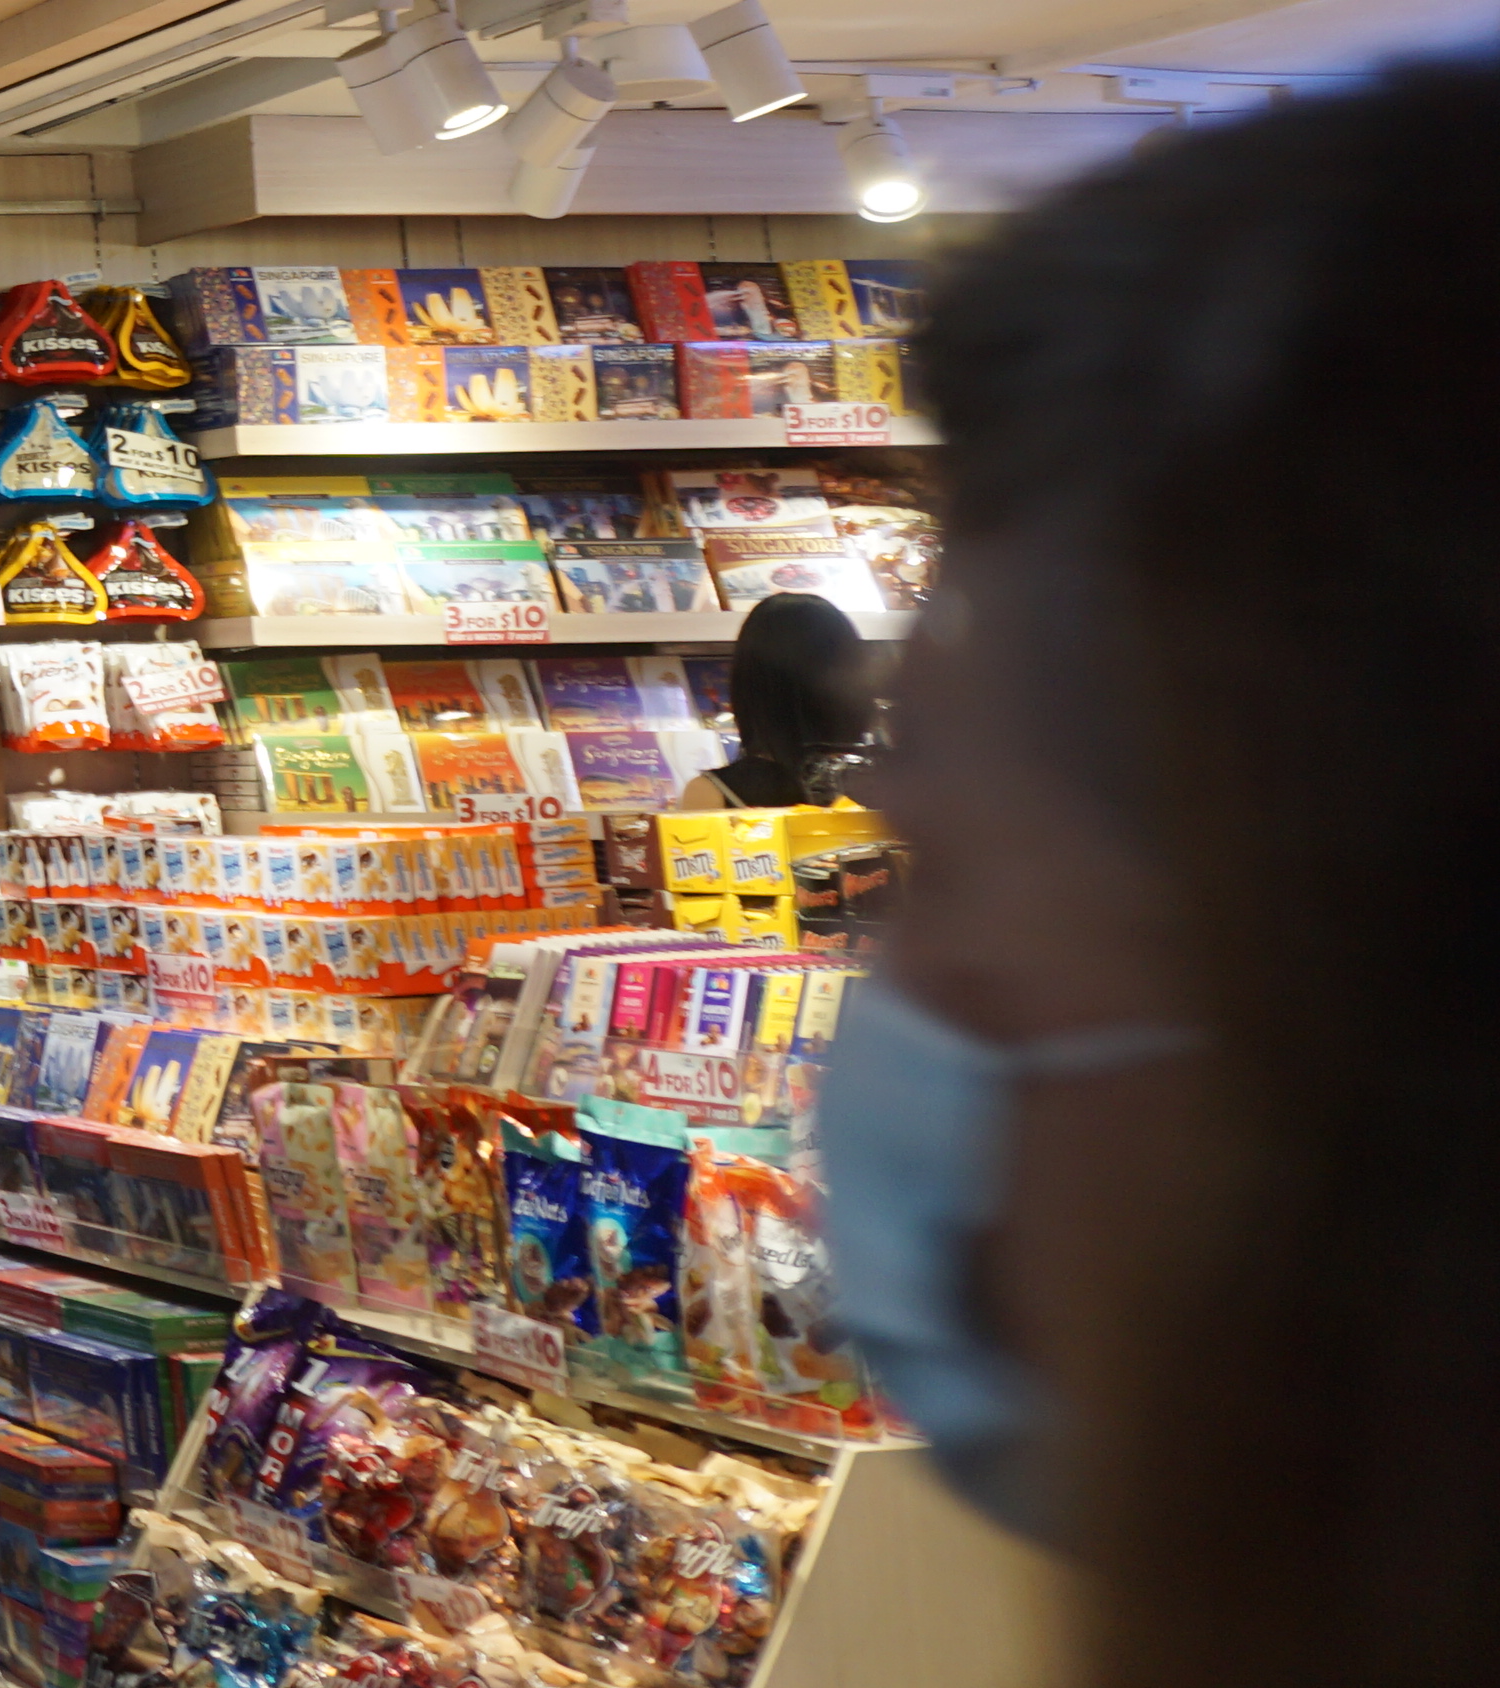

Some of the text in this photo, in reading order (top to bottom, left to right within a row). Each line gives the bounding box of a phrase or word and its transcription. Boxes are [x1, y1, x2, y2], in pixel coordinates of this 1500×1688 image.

[258, 270, 337, 282] SINGAPORE
[22, 337, 99, 351] KISSES
[594, 349, 675, 362] SINGAPORE
[788, 406, 888, 429] 3 FOR $10
[111, 434, 129, 456] 2
[16, 462, 91, 474] KISSES
[586, 544, 665, 557] SINGAPORE
[727, 537, 845, 555] SINGAPORE
[8, 588, 86, 604] KISSES
[105, 582, 185, 598] KISSES
[447, 605, 544, 629] 3 FOR $10
[128, 666, 219, 700] 2 FOR $10
[458, 796, 564, 823] 3 FOR $10
[150, 958, 161, 980] 3
[181, 962, 209, 991] $10
[645, 1053, 739, 1099] 4 FOR $10
[2, 1202, 14, 1222] 3
[293, 1358, 329, 1397] 1
